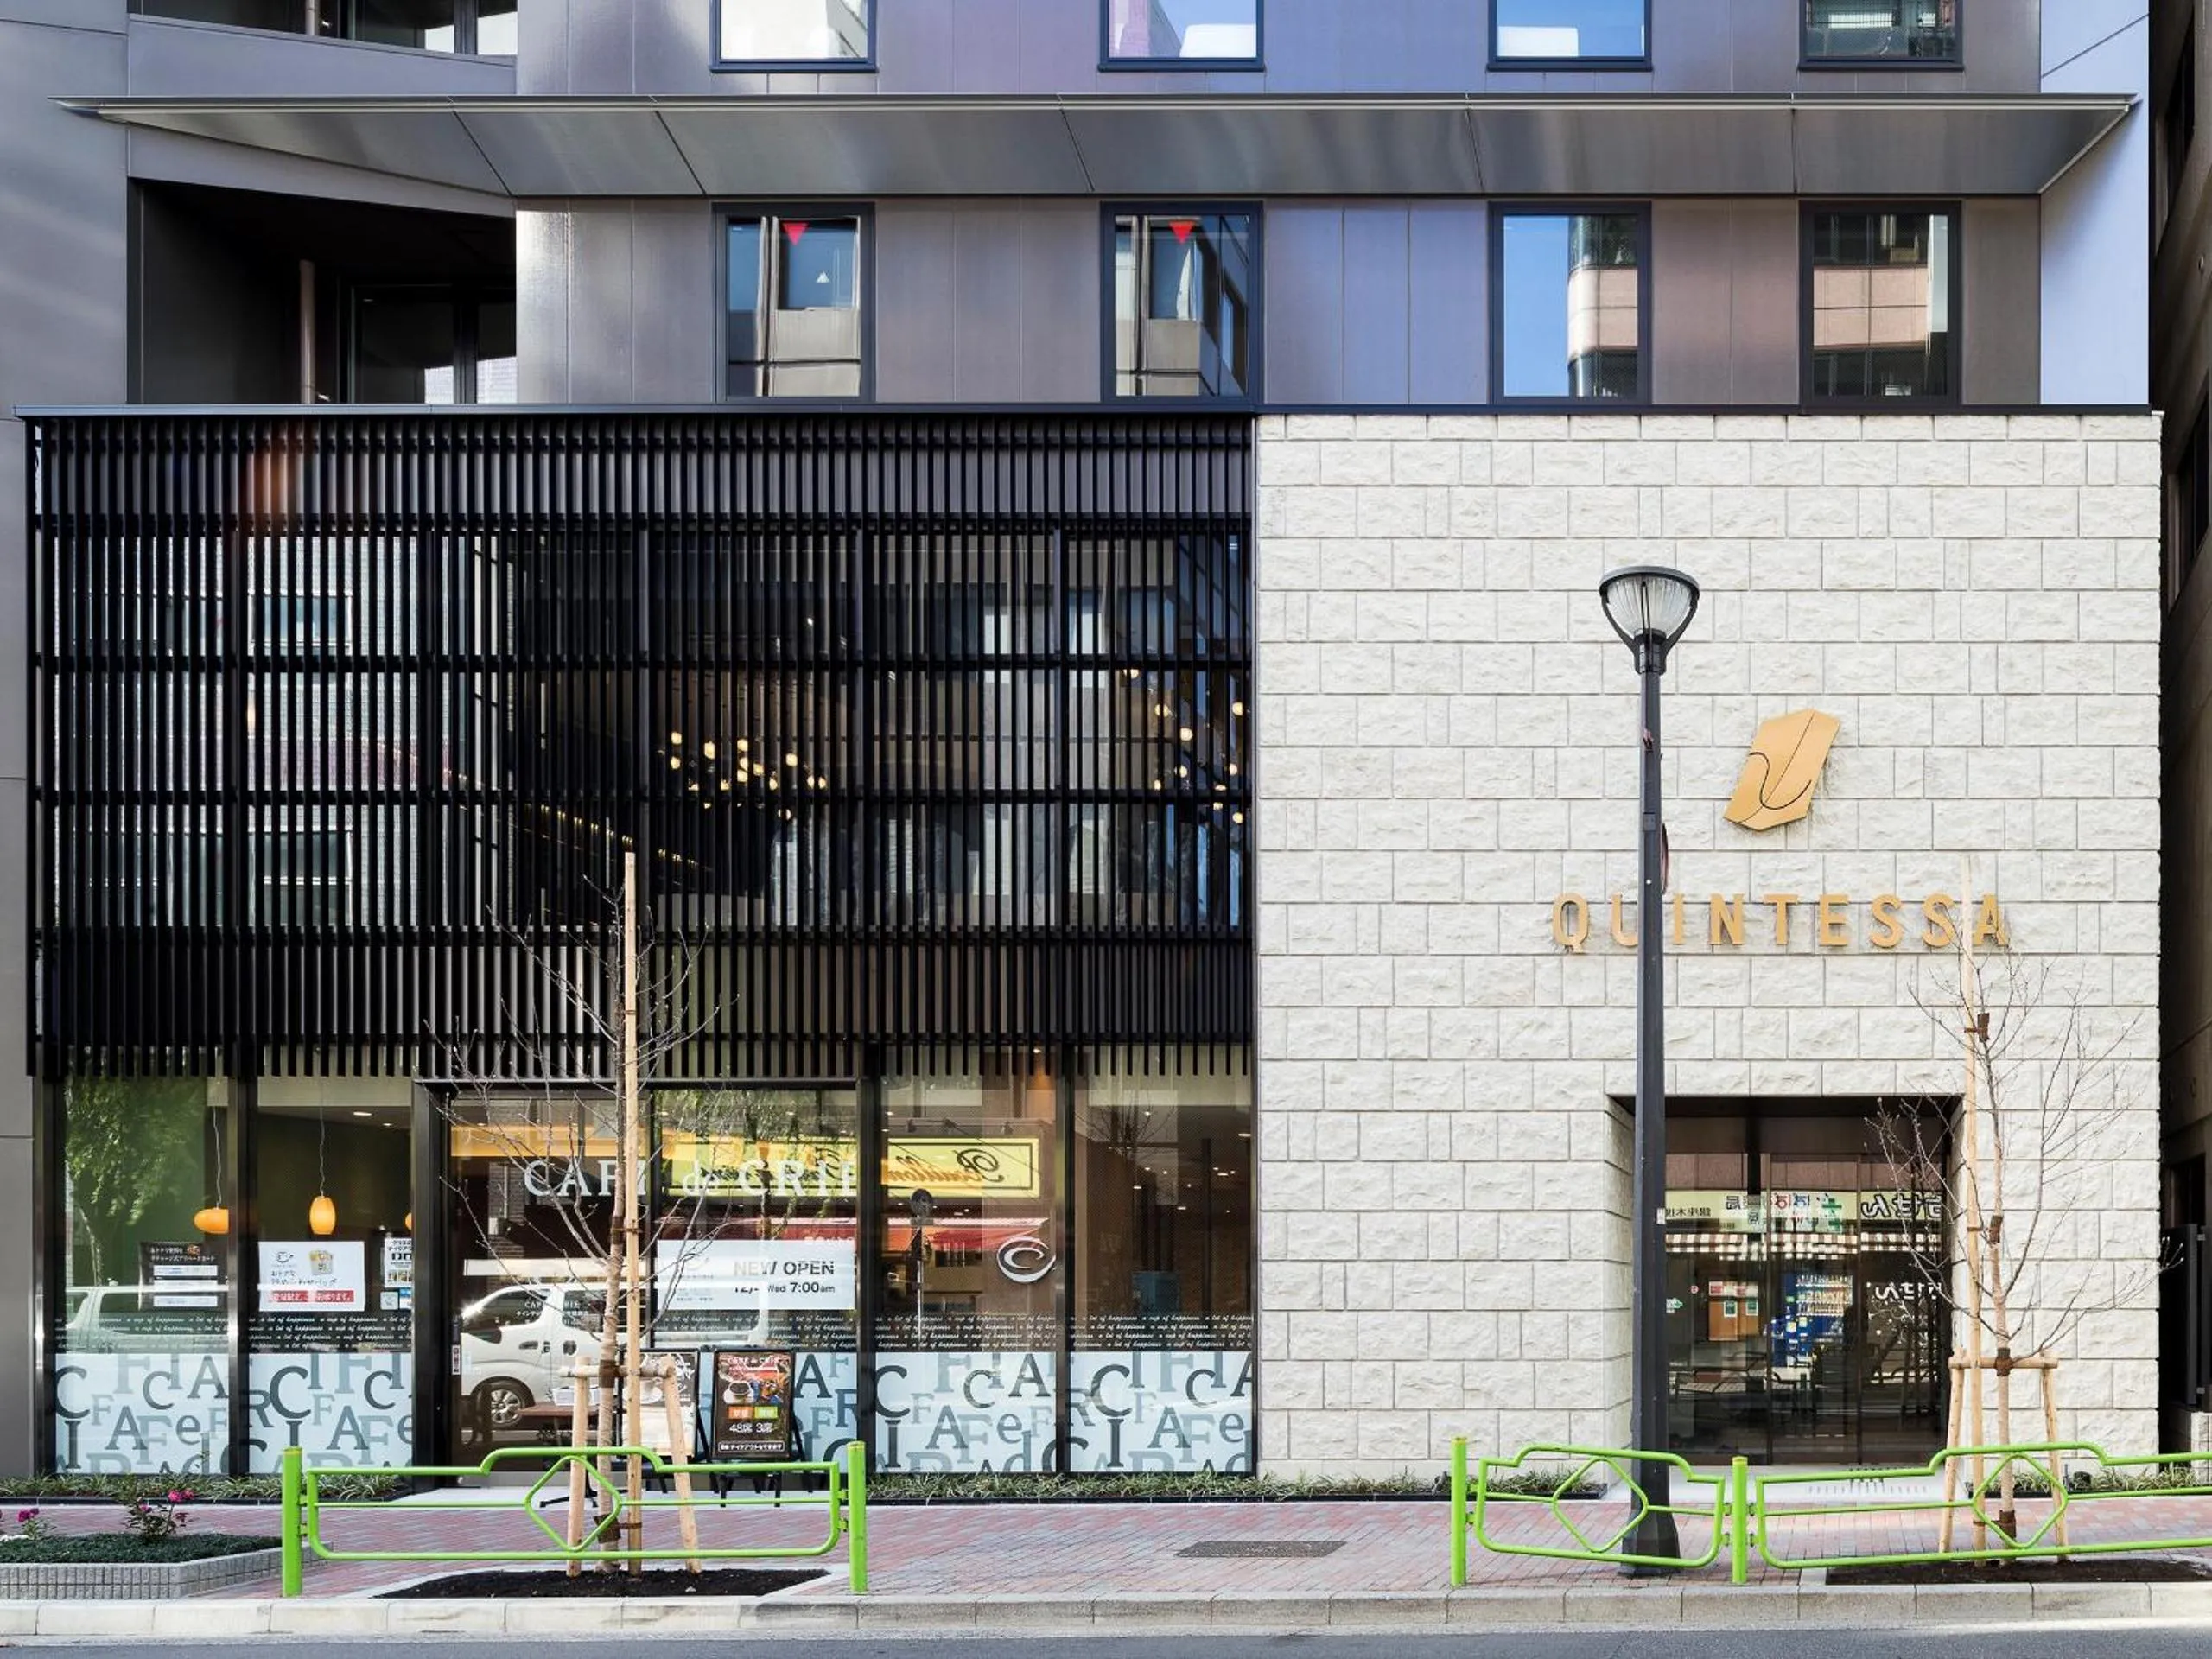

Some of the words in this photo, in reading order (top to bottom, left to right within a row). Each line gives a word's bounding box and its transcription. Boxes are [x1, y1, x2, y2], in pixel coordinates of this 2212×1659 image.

[1552, 892, 2007, 953] QUINTESSA
[734, 1261, 777, 1275] NEW
[784, 1261, 835, 1275] OPEN
